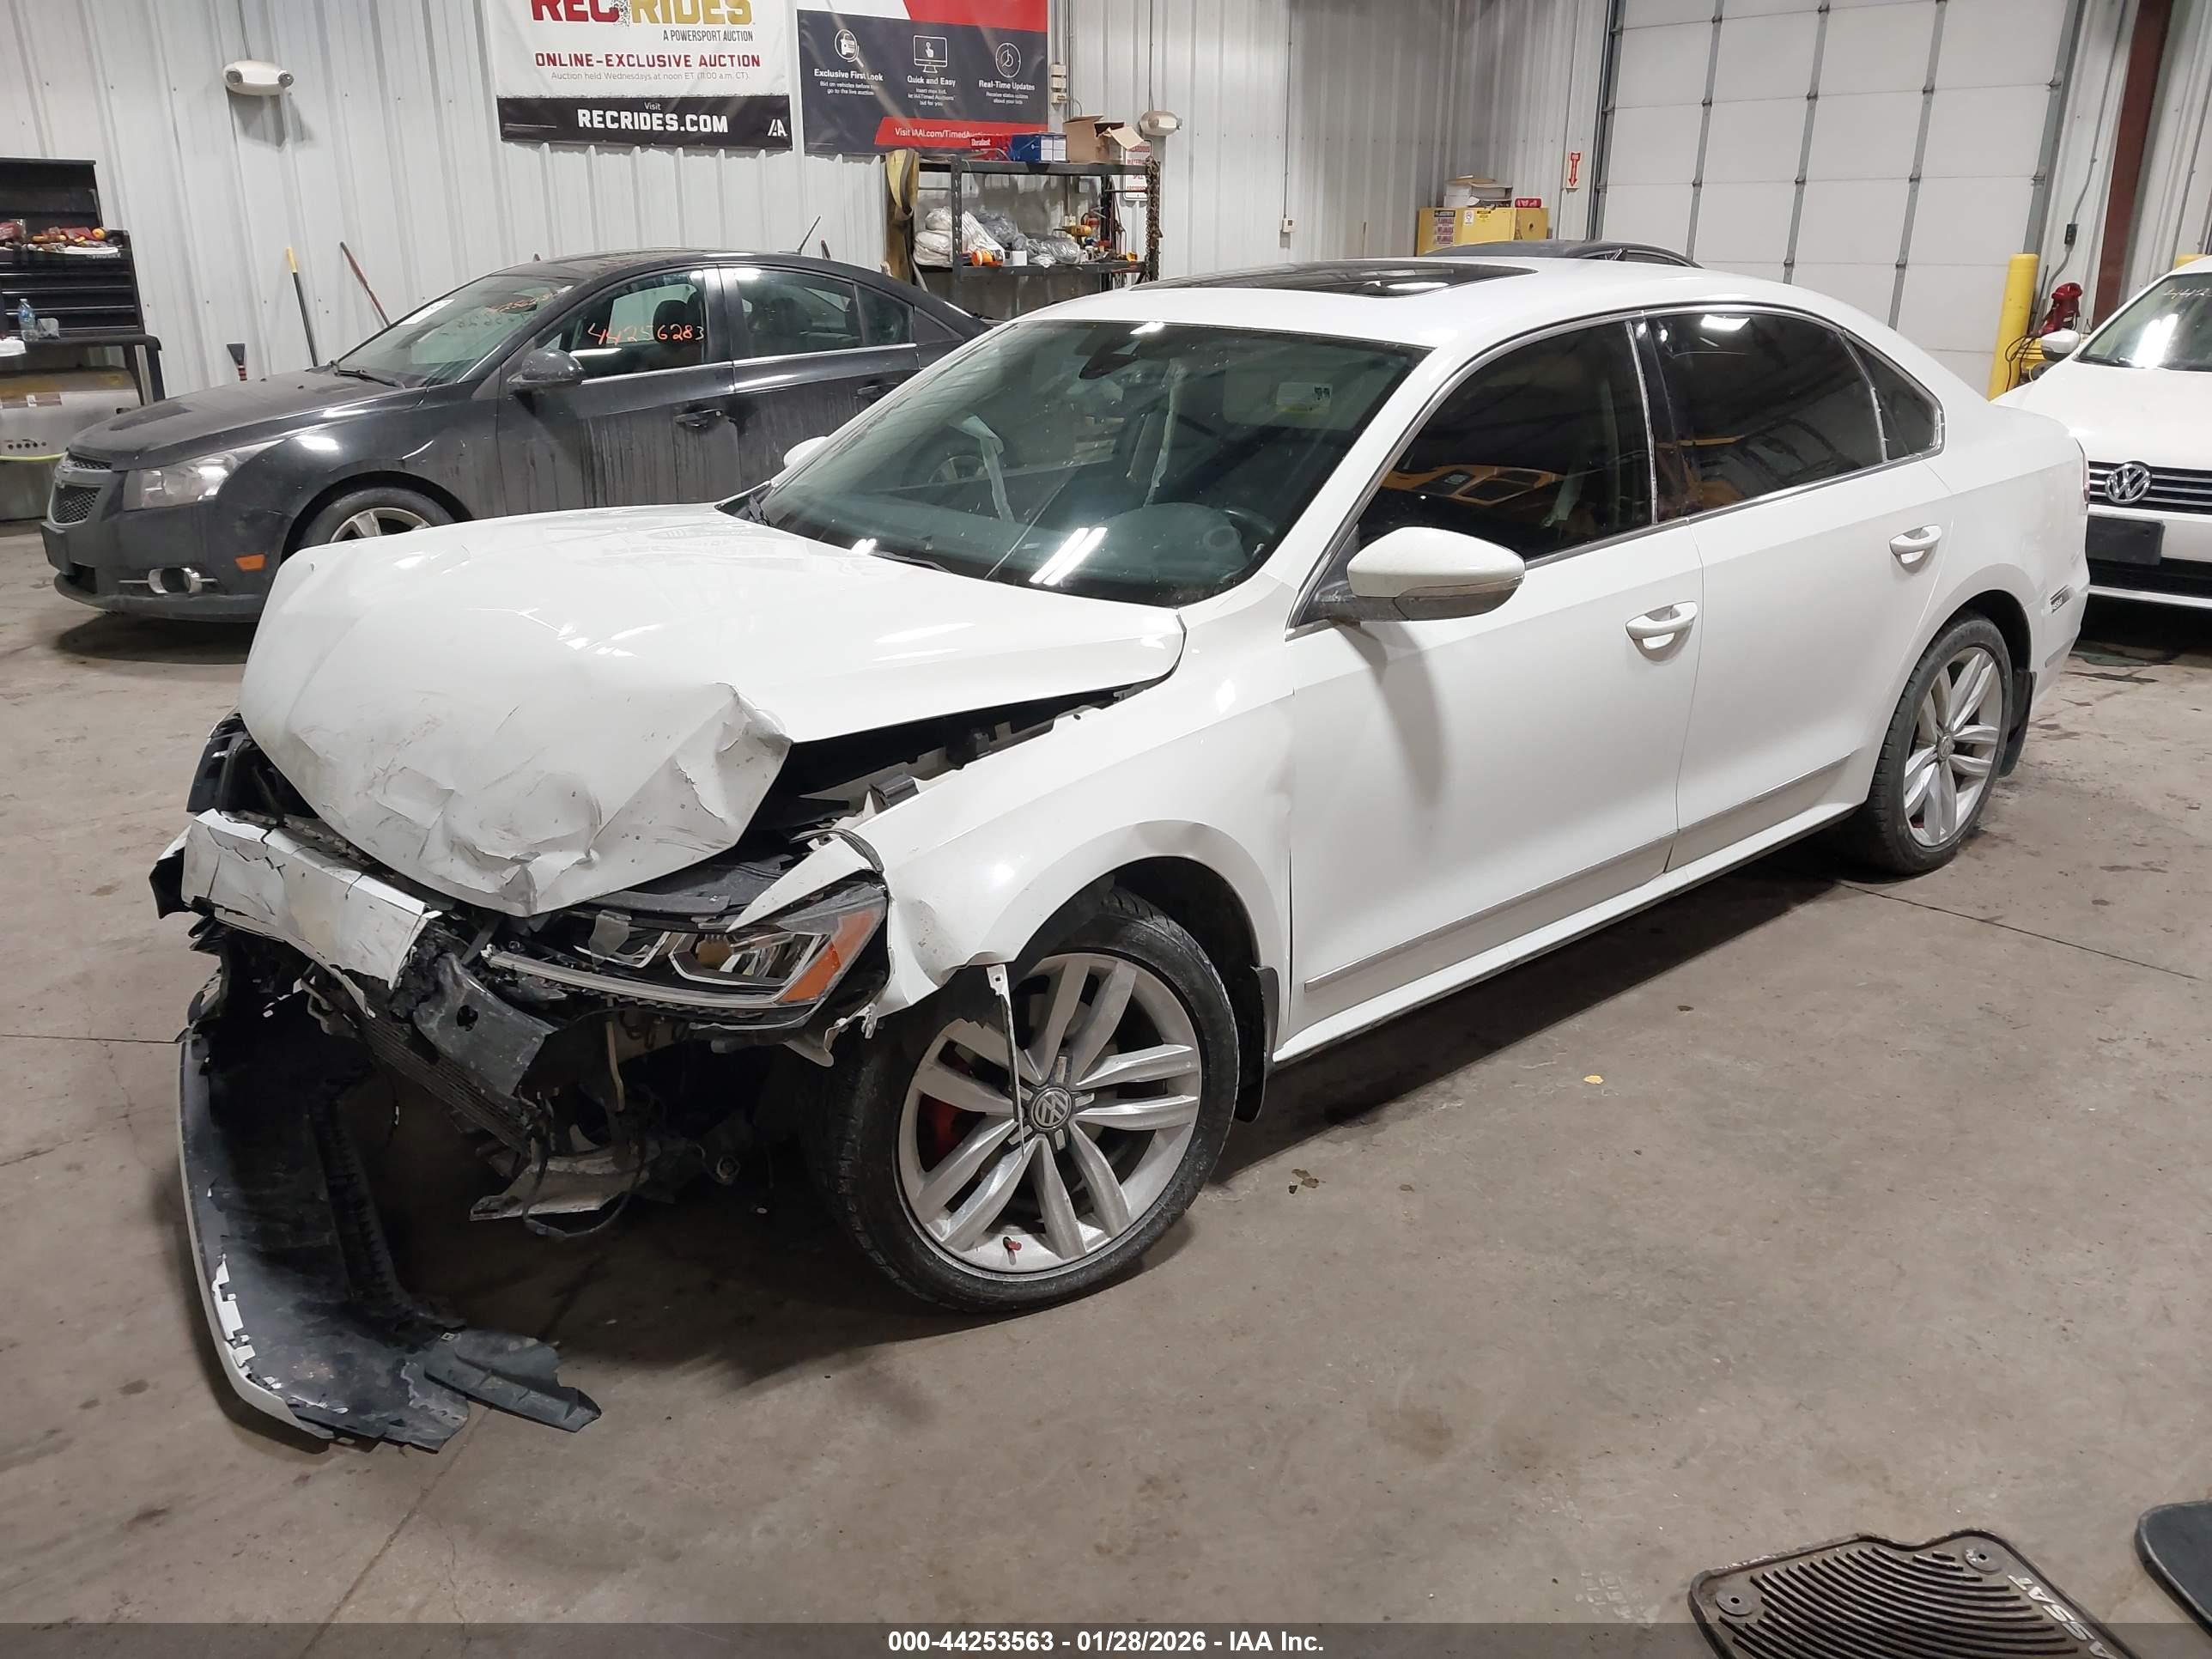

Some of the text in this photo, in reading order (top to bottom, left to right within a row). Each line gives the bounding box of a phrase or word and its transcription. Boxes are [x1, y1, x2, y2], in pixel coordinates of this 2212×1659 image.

[531, 0, 754, 25] REC RIDES
[663, 29, 755, 42] A POWERSPORT AUCTION
[535, 52, 762, 68] ONLINE-EXCLUSIVE AUCTION
[551, 71, 582, 80] Auction
[584, 71, 602, 80] held
[604, 71, 652, 82] Wednesdays
[814, 68, 884, 82] Exclusive First Look
[907, 75, 956, 88] Quick and Easy
[978, 79, 1036, 91] Real-Time Updates
[644, 102, 661, 112] Visit
[577, 109, 729, 134] RECRIDES.COM
[895, 127, 910, 137] Visit
